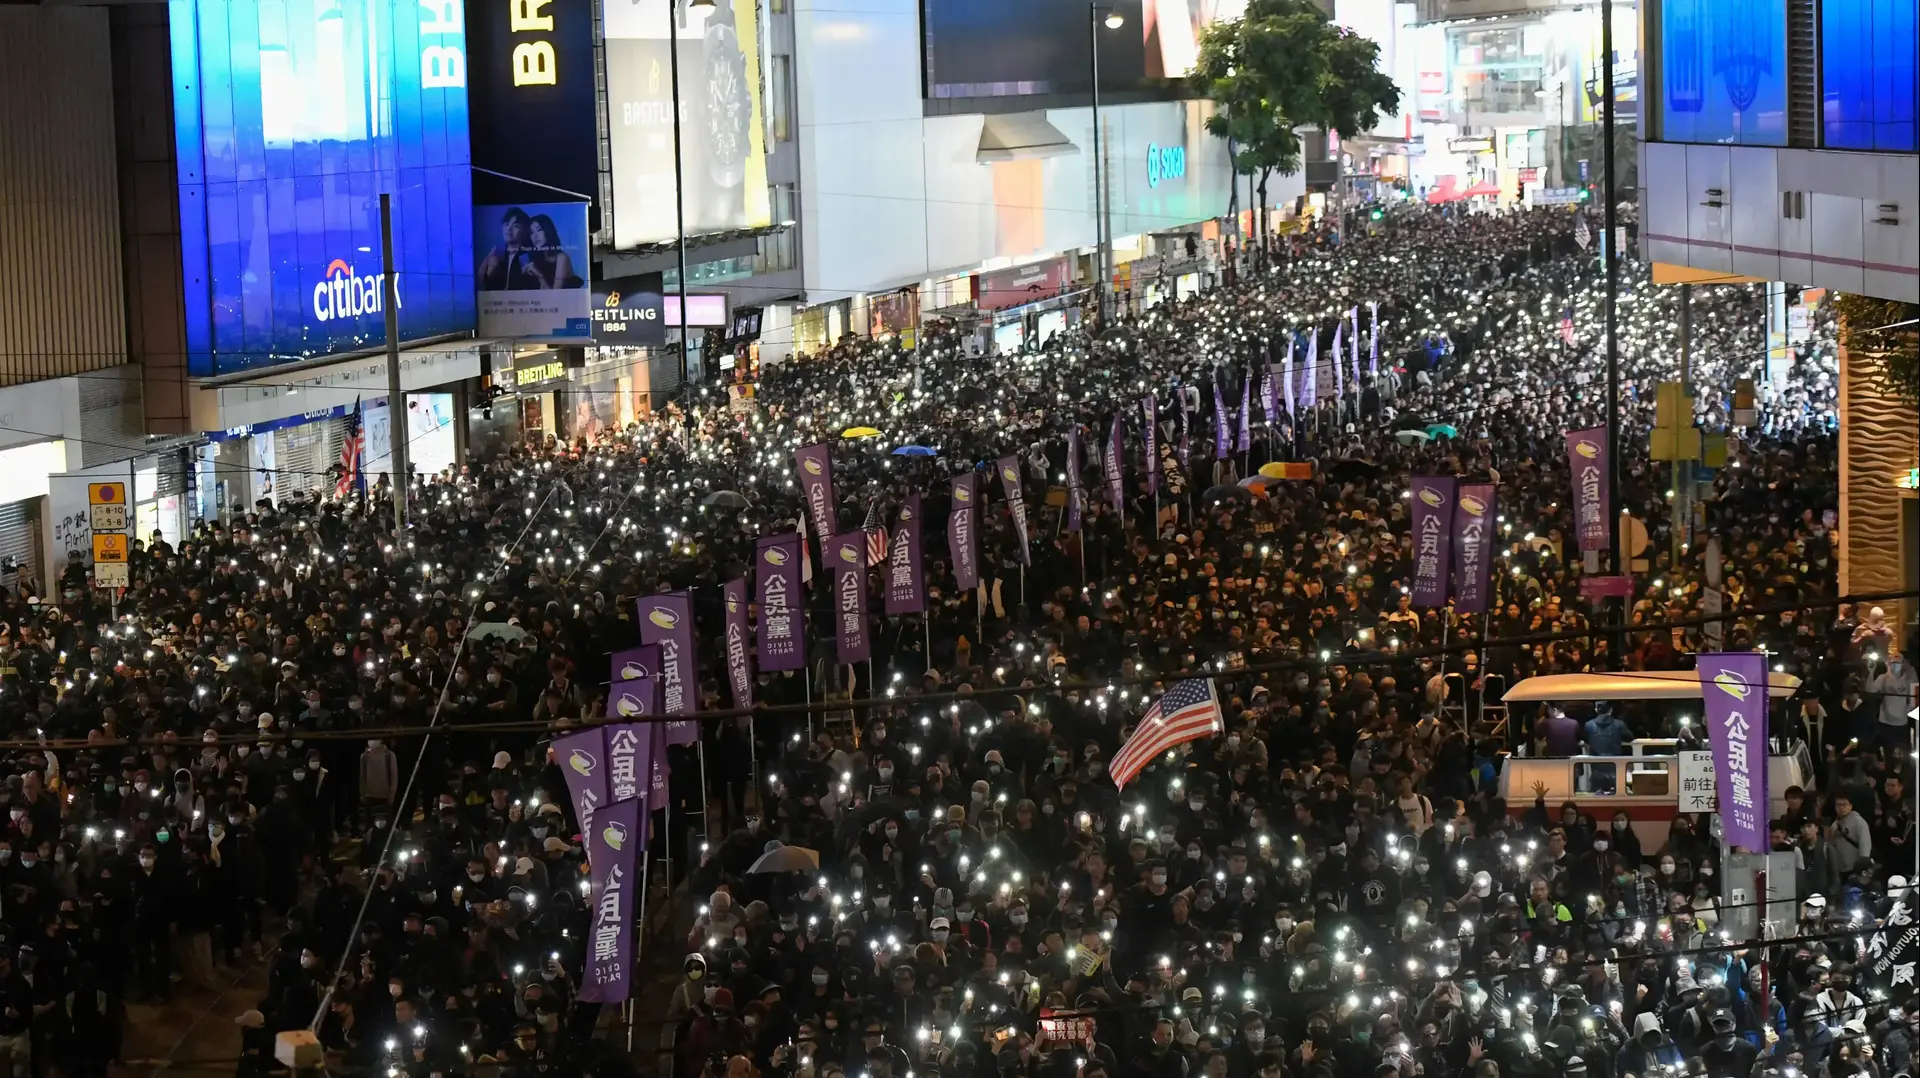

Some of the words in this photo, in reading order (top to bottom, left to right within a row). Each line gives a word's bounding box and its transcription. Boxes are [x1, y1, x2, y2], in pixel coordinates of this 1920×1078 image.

[603, 322, 627, 332] 1884
[105, 506, 123, 514] 8-10
[106, 518, 122, 526] 5-8
[65, 528, 90, 551] FIGHT
